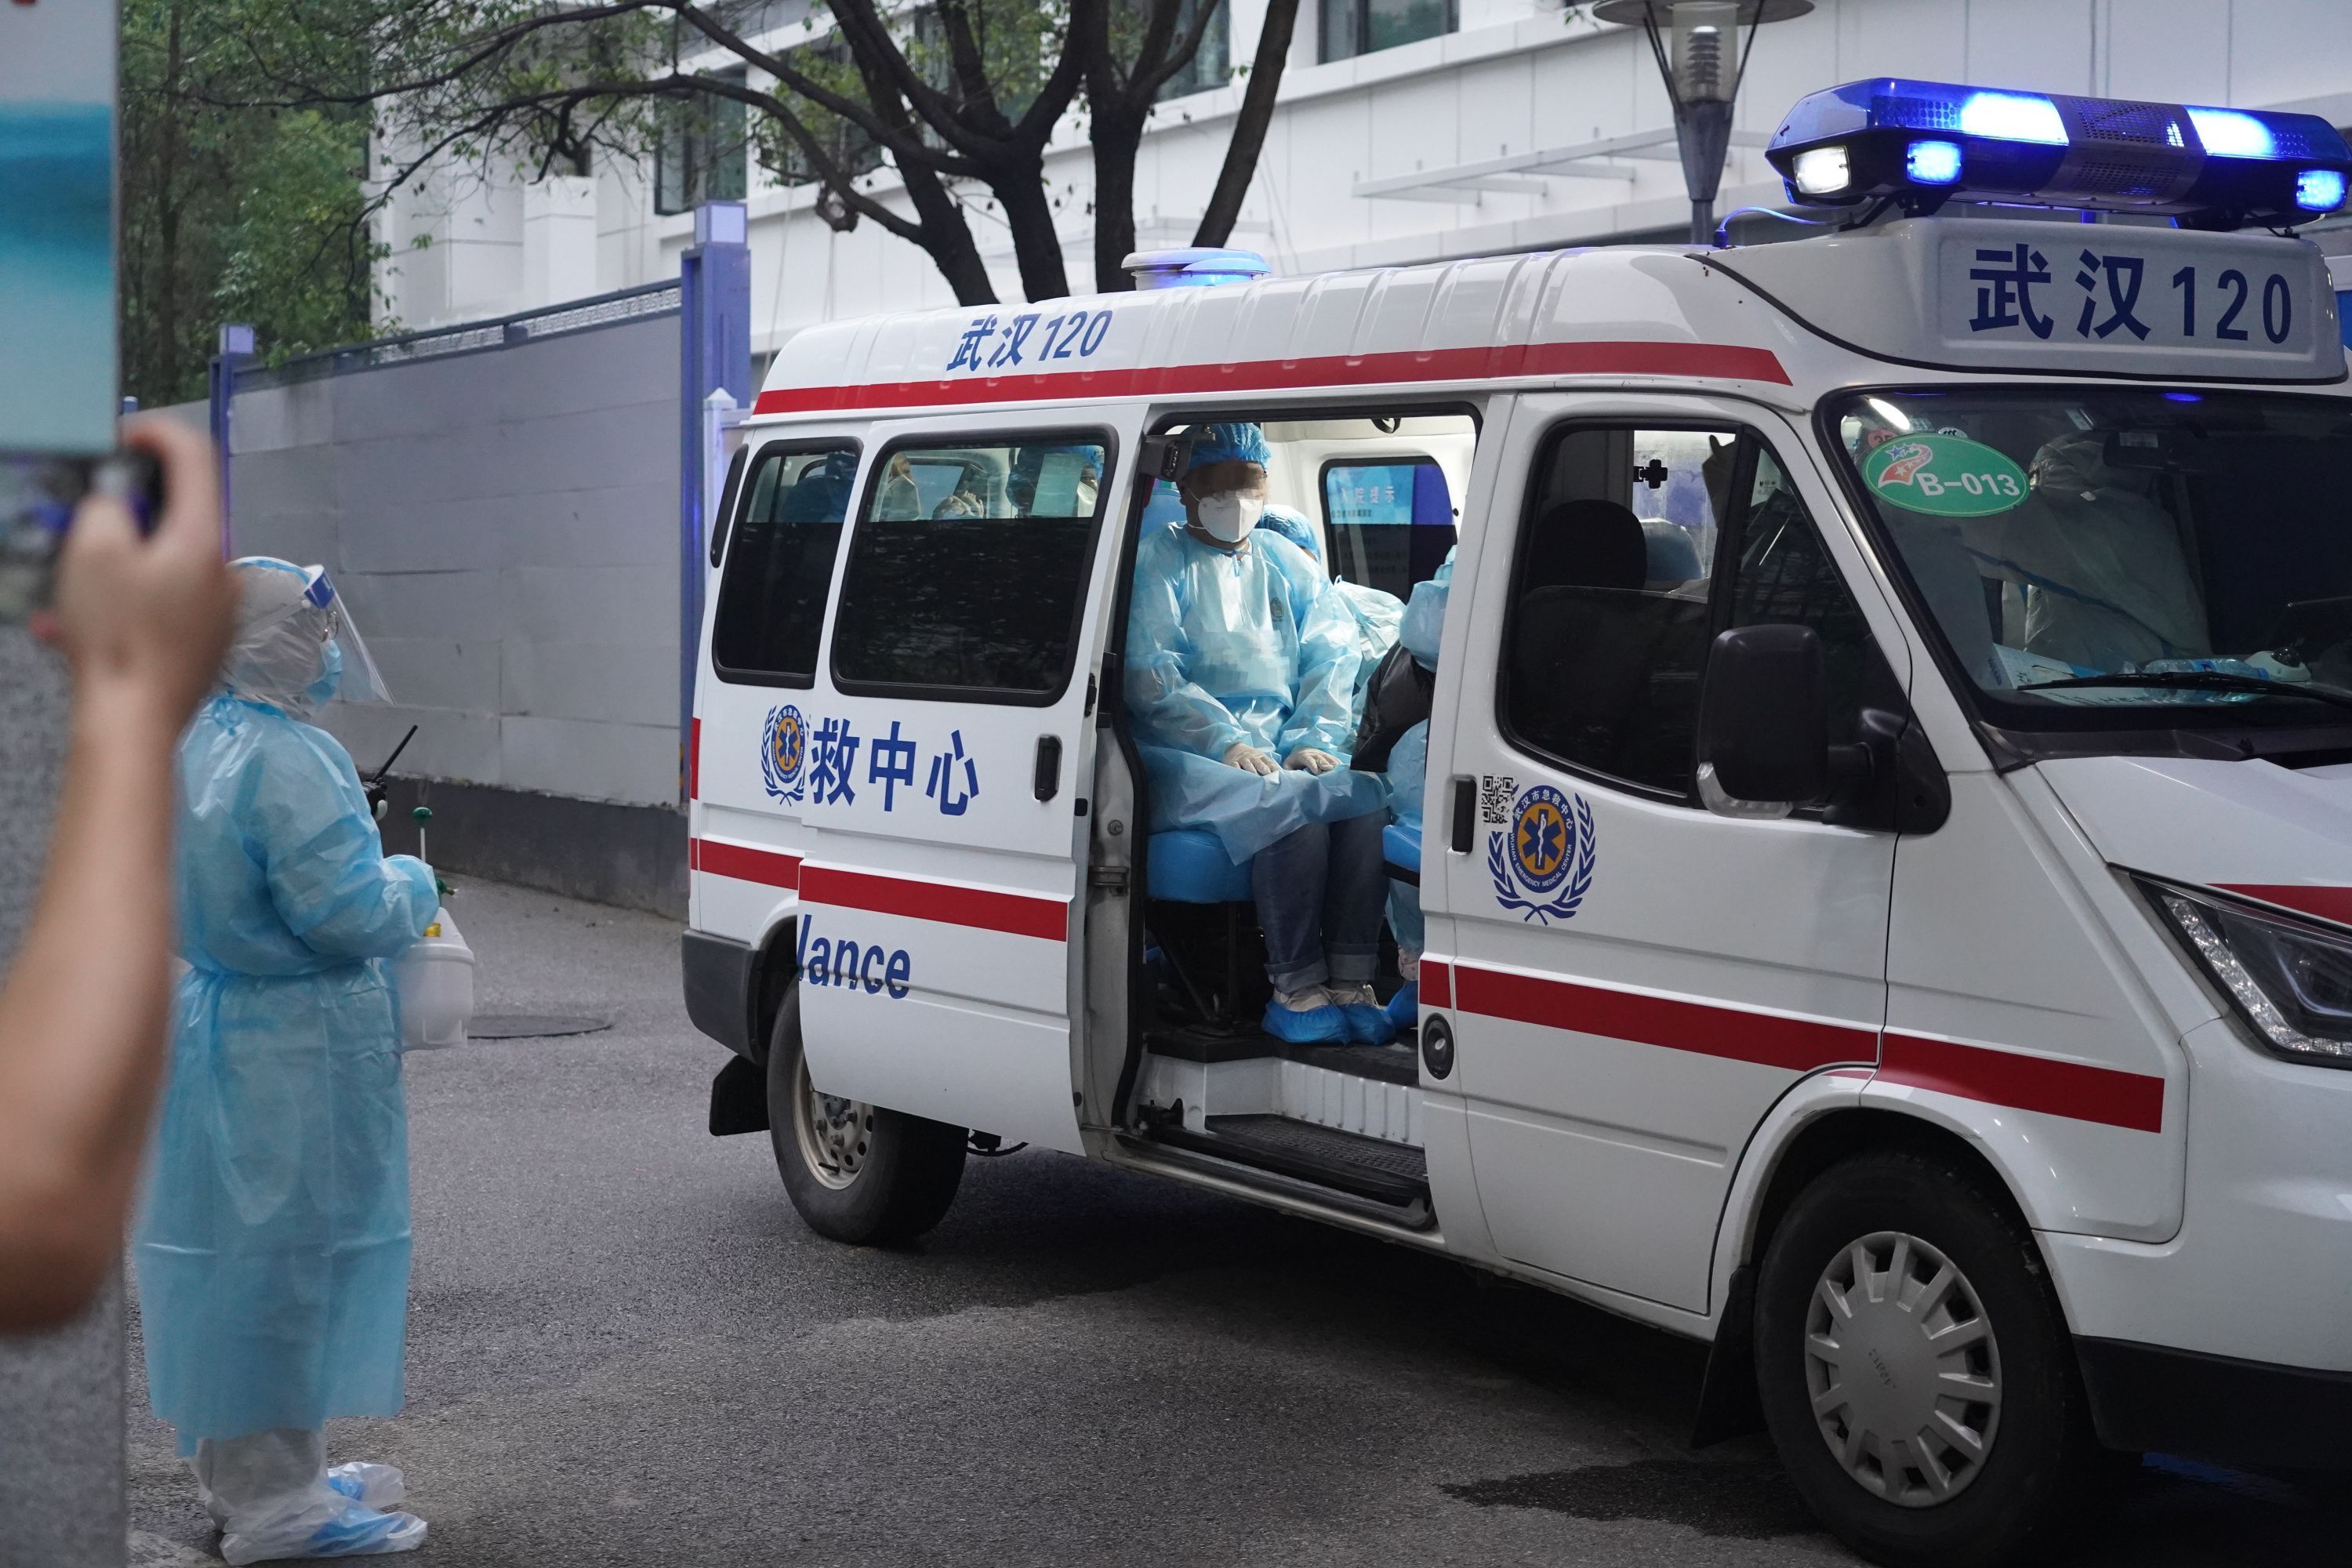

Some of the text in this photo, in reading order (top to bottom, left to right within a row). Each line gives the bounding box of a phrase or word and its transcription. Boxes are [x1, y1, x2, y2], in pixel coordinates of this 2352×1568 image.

[1969, 243, 2292, 343] 武汉120
[946, 310, 1112, 372] 武汉120
[1916, 473, 2020, 496] B-013
[809, 717, 980, 816] 救中心
[1513, 789, 1573, 831] 武汉市急救中心
[1515, 862, 1541, 887] EMERGENCY
[1541, 871, 1563, 887] MEDICAL
[1561, 844, 1573, 870] CENTER
[798, 913, 911, 1000] lance
